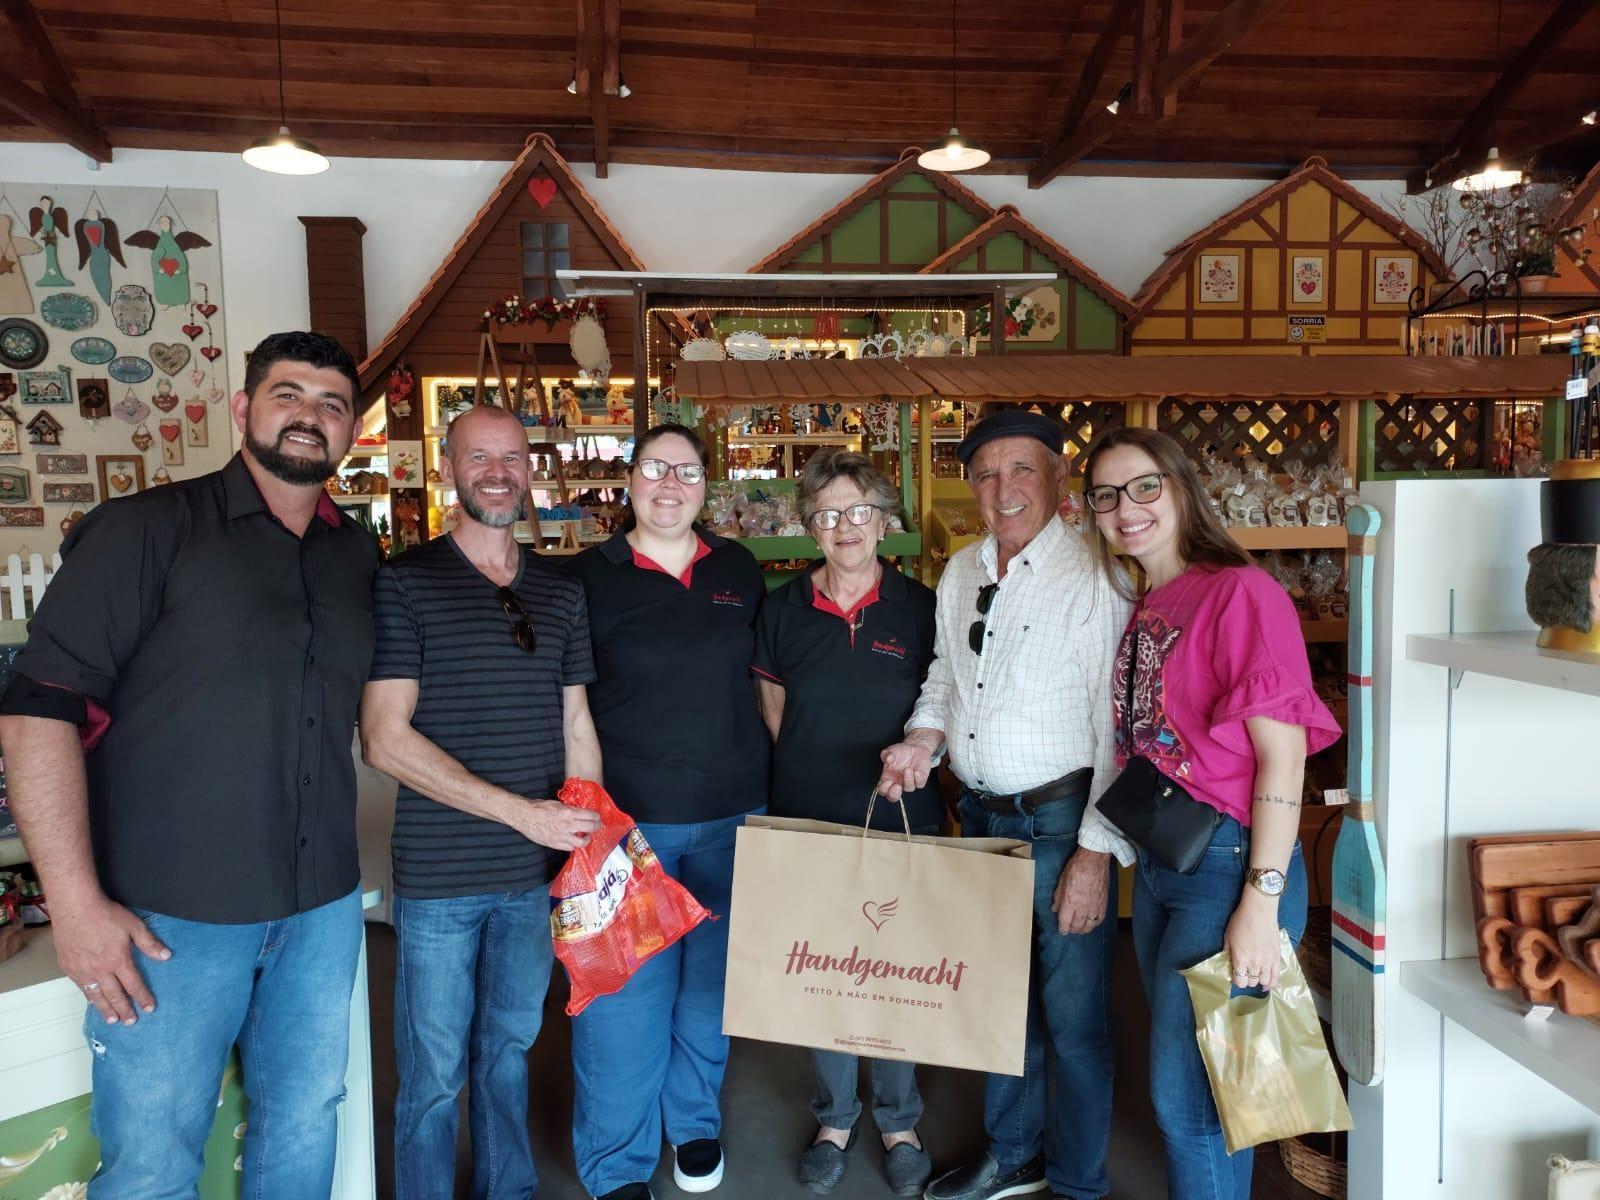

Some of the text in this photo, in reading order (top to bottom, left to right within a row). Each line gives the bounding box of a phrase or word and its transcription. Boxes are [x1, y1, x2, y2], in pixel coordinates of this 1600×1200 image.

[1291, 317, 1322, 325] SORRIA
[785, 940, 969, 992] Handgemacht
[804, 986, 832, 996] FEITO
[847, 990, 868, 1000] MÃO
[872, 994, 885, 1002] EM
[889, 996, 944, 1010] POMERODE
